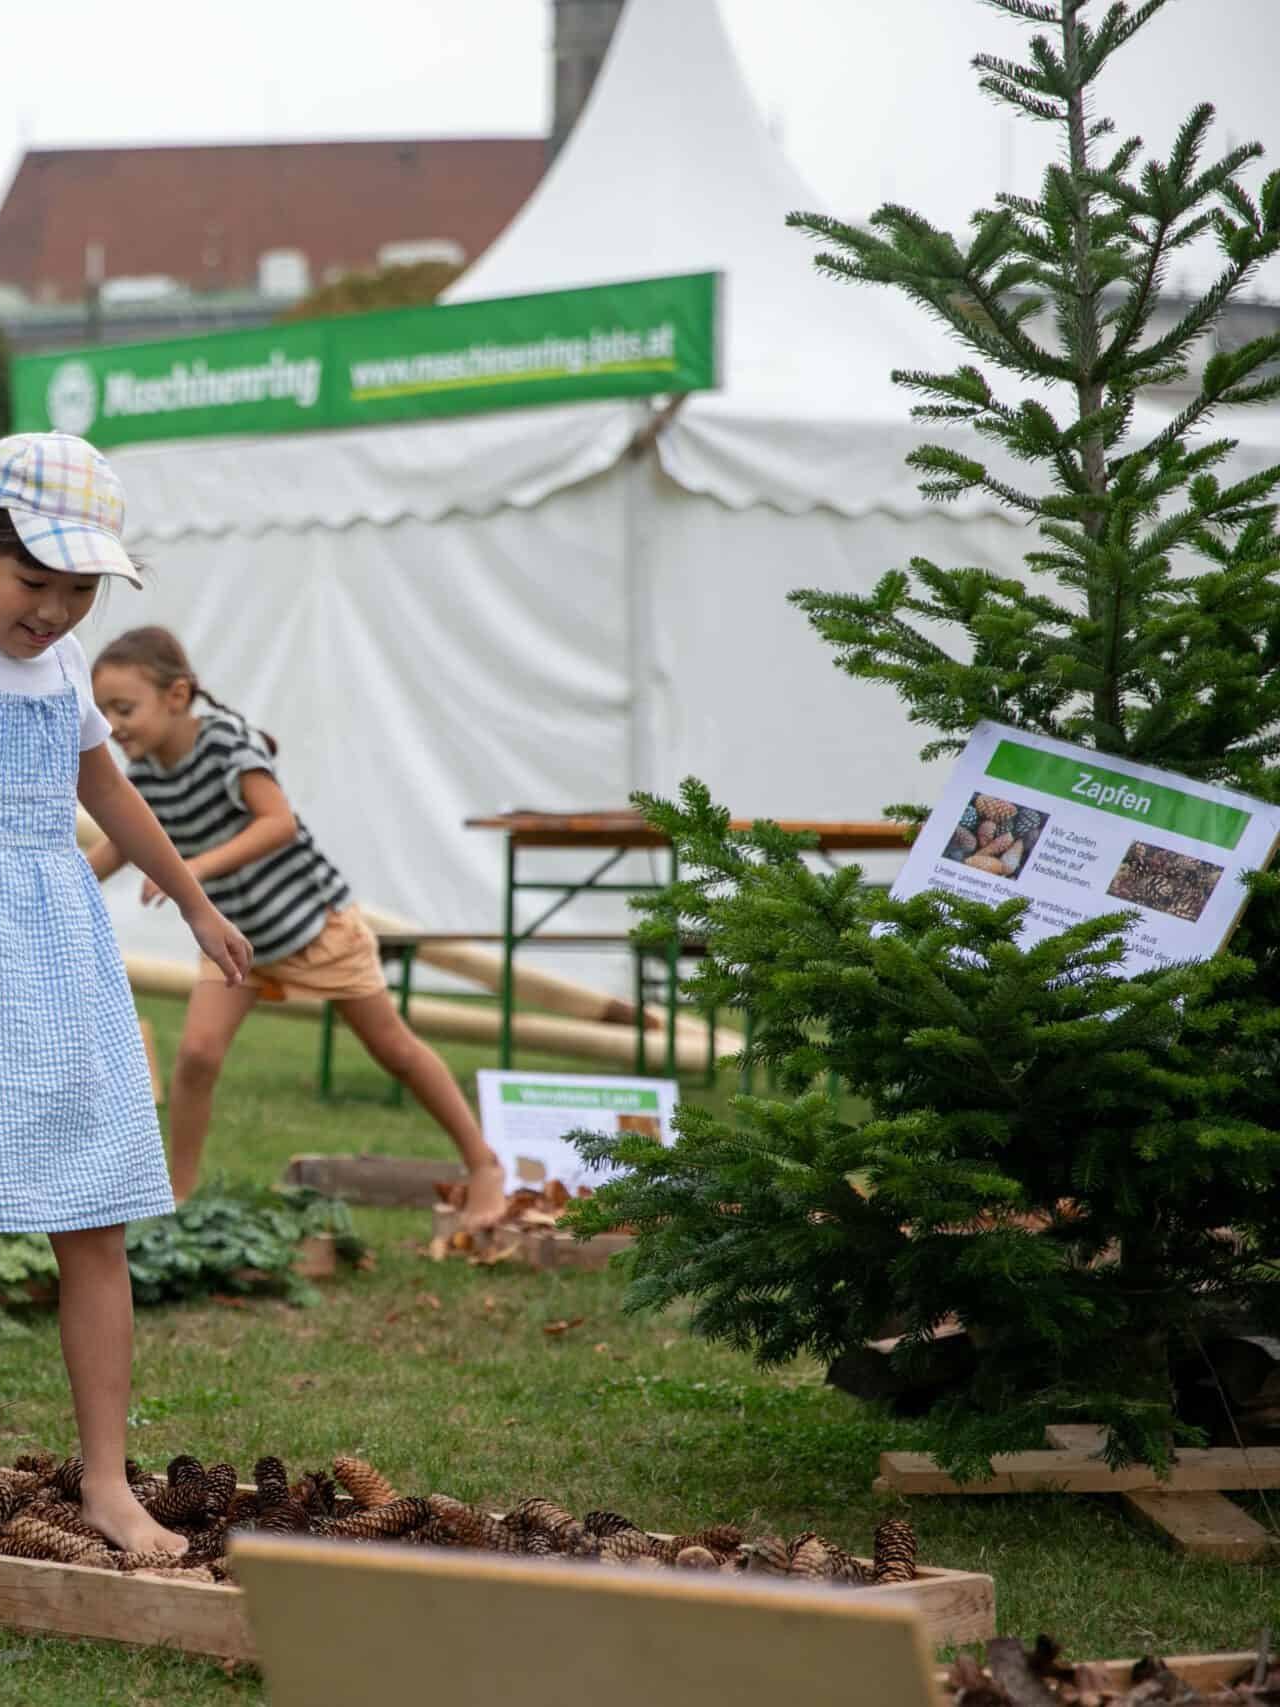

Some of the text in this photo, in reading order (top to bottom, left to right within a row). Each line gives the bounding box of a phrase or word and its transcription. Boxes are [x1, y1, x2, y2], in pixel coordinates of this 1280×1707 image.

[104, 351, 321, 414] Maschinenring
[1071, 773, 1151, 815] Zapfen
[1066, 831, 1097, 849] Zapfen
[1038, 851, 1084, 872] stehen auf
[1077, 848, 1099, 861] oder
[934, 863, 957, 878] Unter
